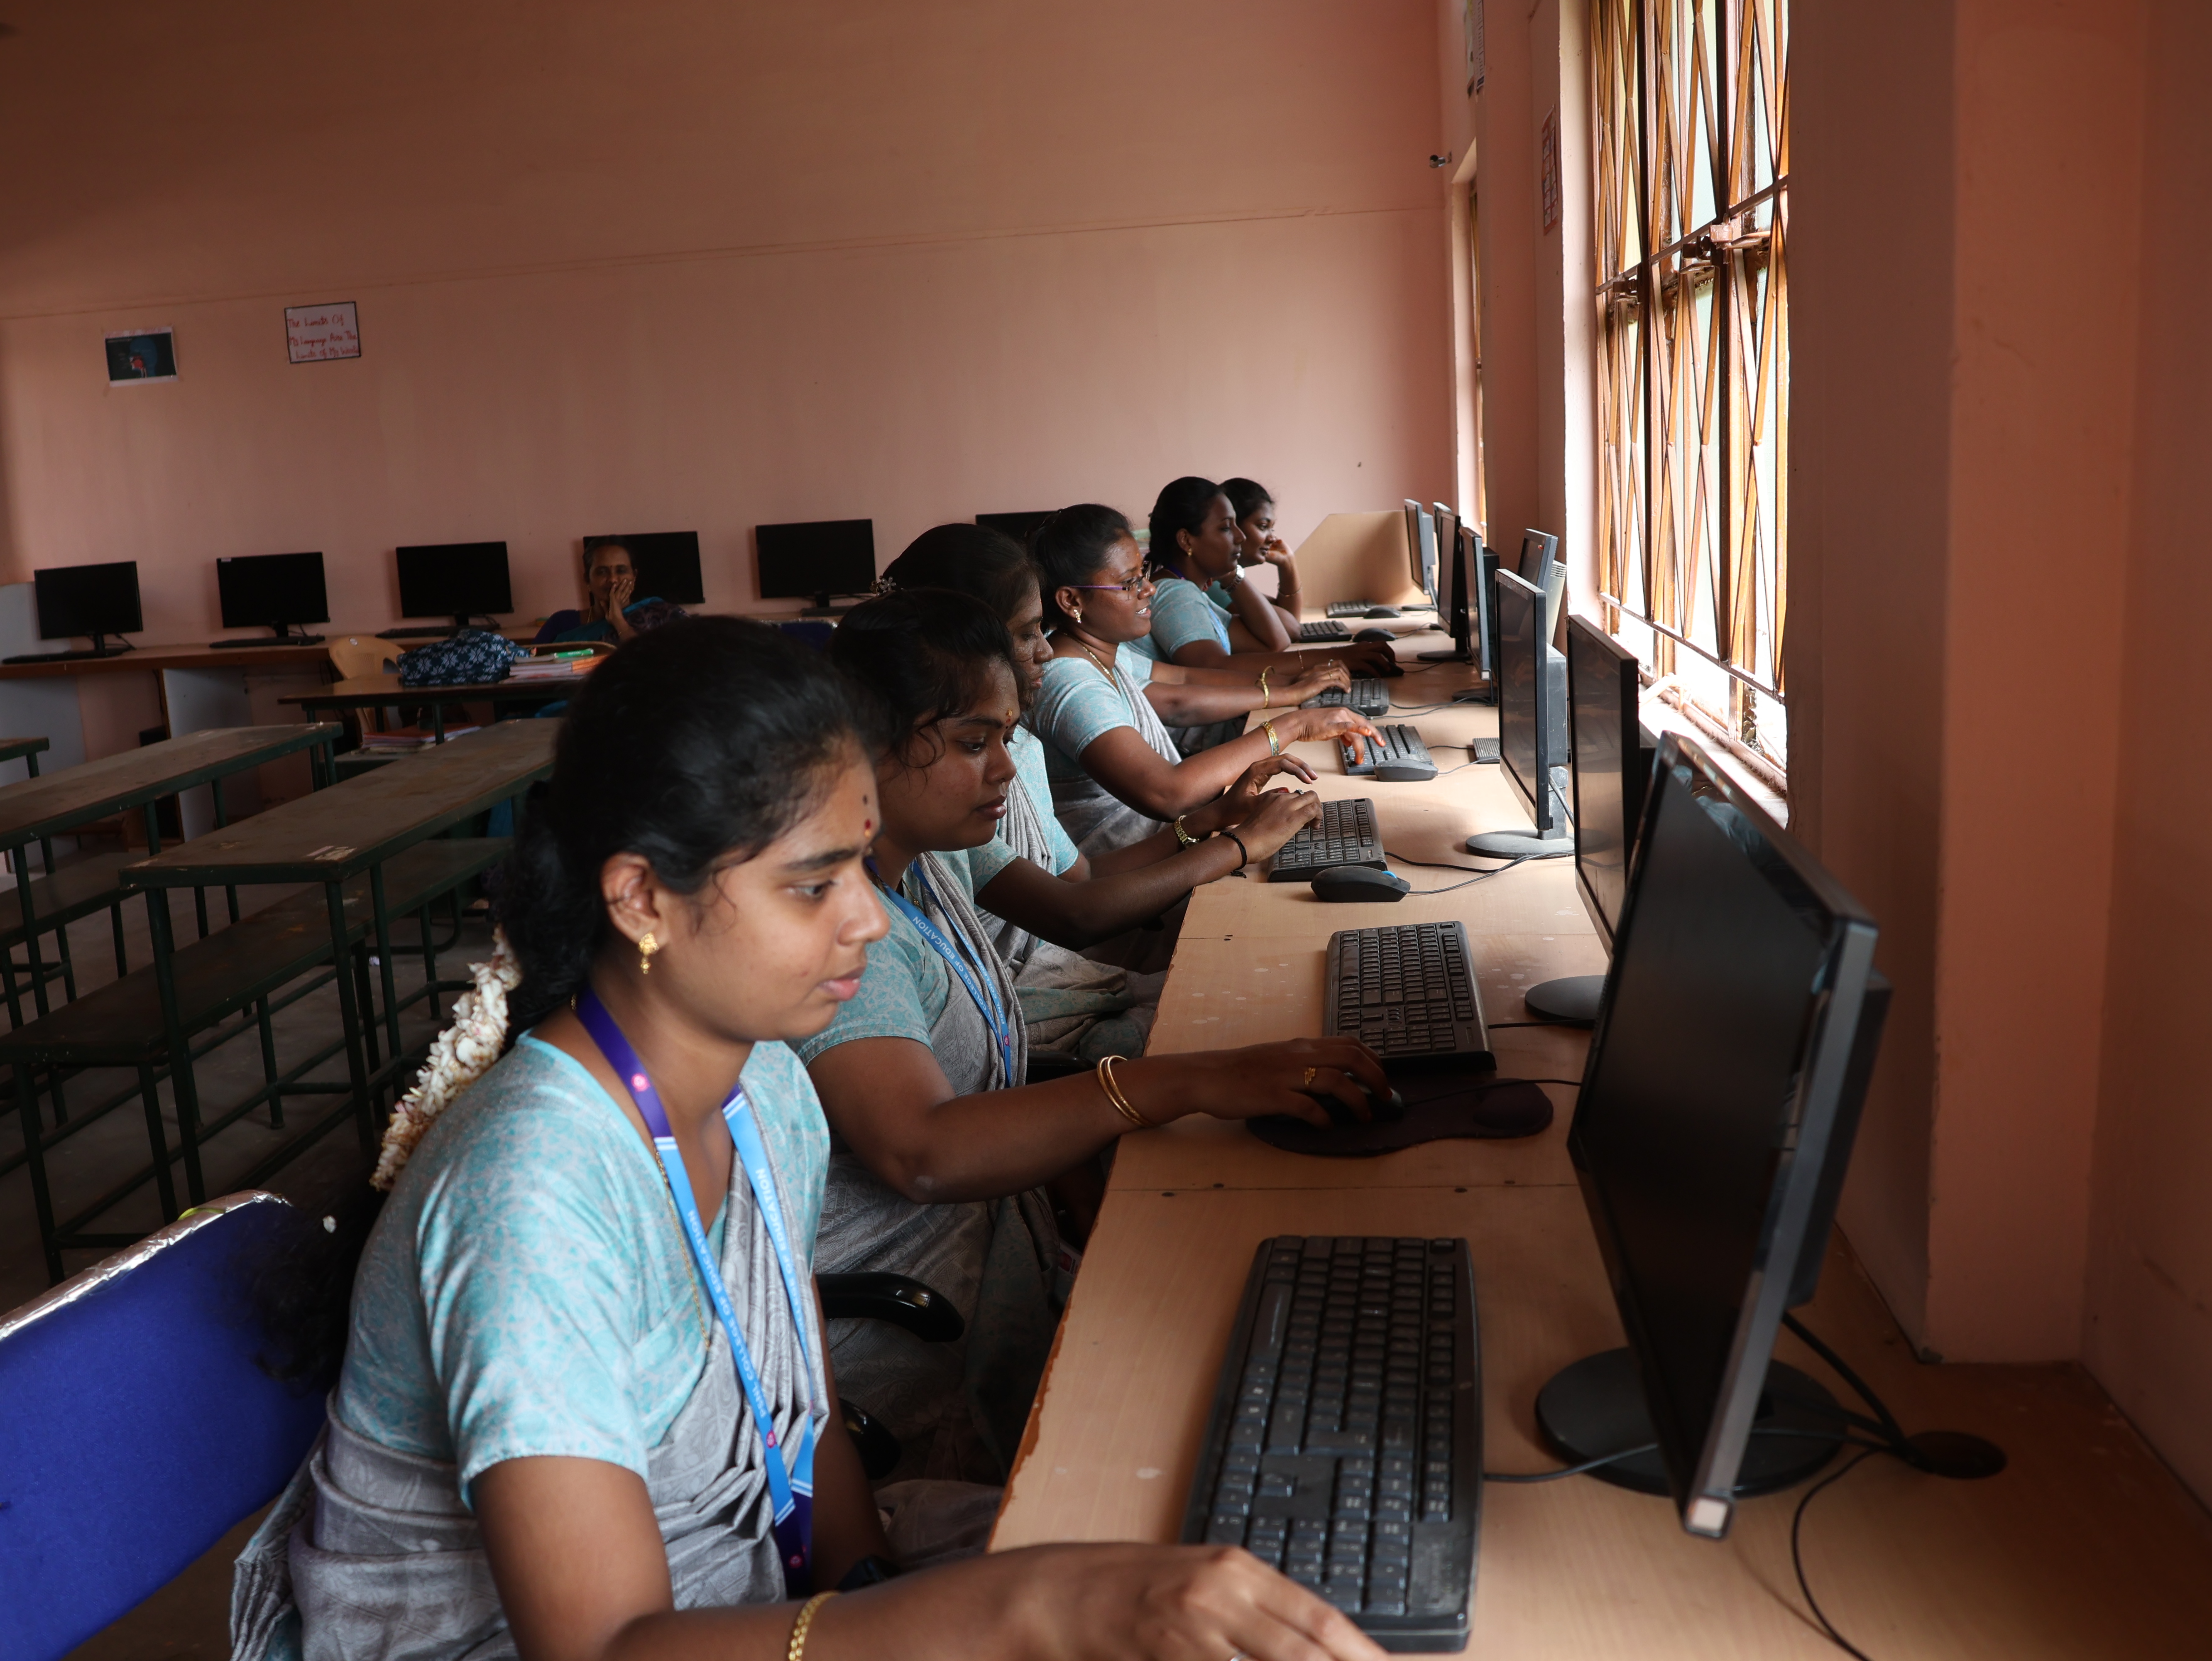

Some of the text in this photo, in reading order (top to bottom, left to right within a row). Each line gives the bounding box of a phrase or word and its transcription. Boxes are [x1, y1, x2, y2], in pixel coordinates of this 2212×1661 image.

[913, 916, 955, 959] EDUCATION
[954, 960, 964, 972] OF
[977, 960, 997, 999] COLLEGE
[964, 972, 986, 1010] COLLEGE
[756, 1168, 787, 1251] EDUCATION
[688, 1210, 722, 1294] EDUCATION
[782, 1254, 793, 1274] OF
[719, 1296, 731, 1316] OF
[728, 1317, 754, 1381] COLLEGE
